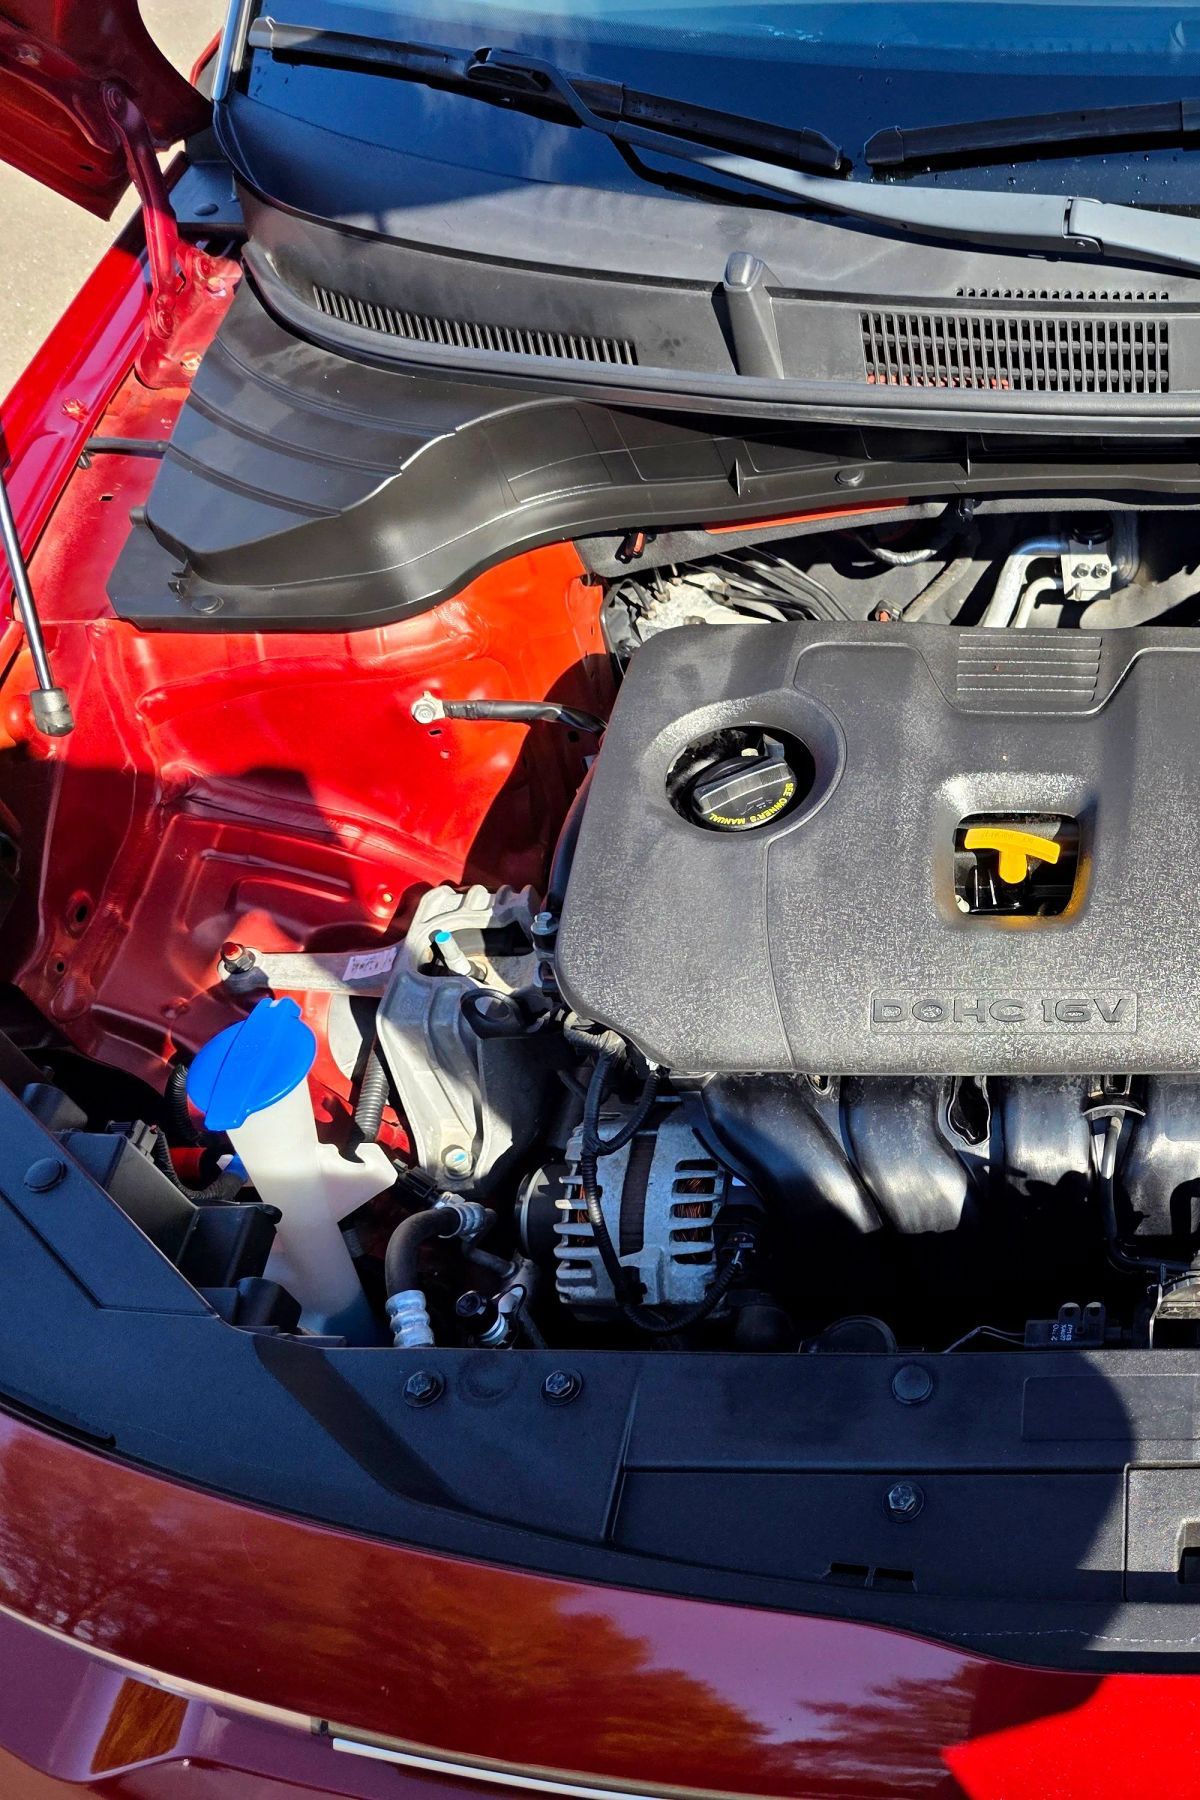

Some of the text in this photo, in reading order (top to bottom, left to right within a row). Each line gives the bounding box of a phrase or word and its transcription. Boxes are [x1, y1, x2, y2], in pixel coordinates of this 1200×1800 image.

[709, 782, 794, 825] SEE OWNER'S MANUAL
[873, 998, 1132, 1023] DOHC 16V
